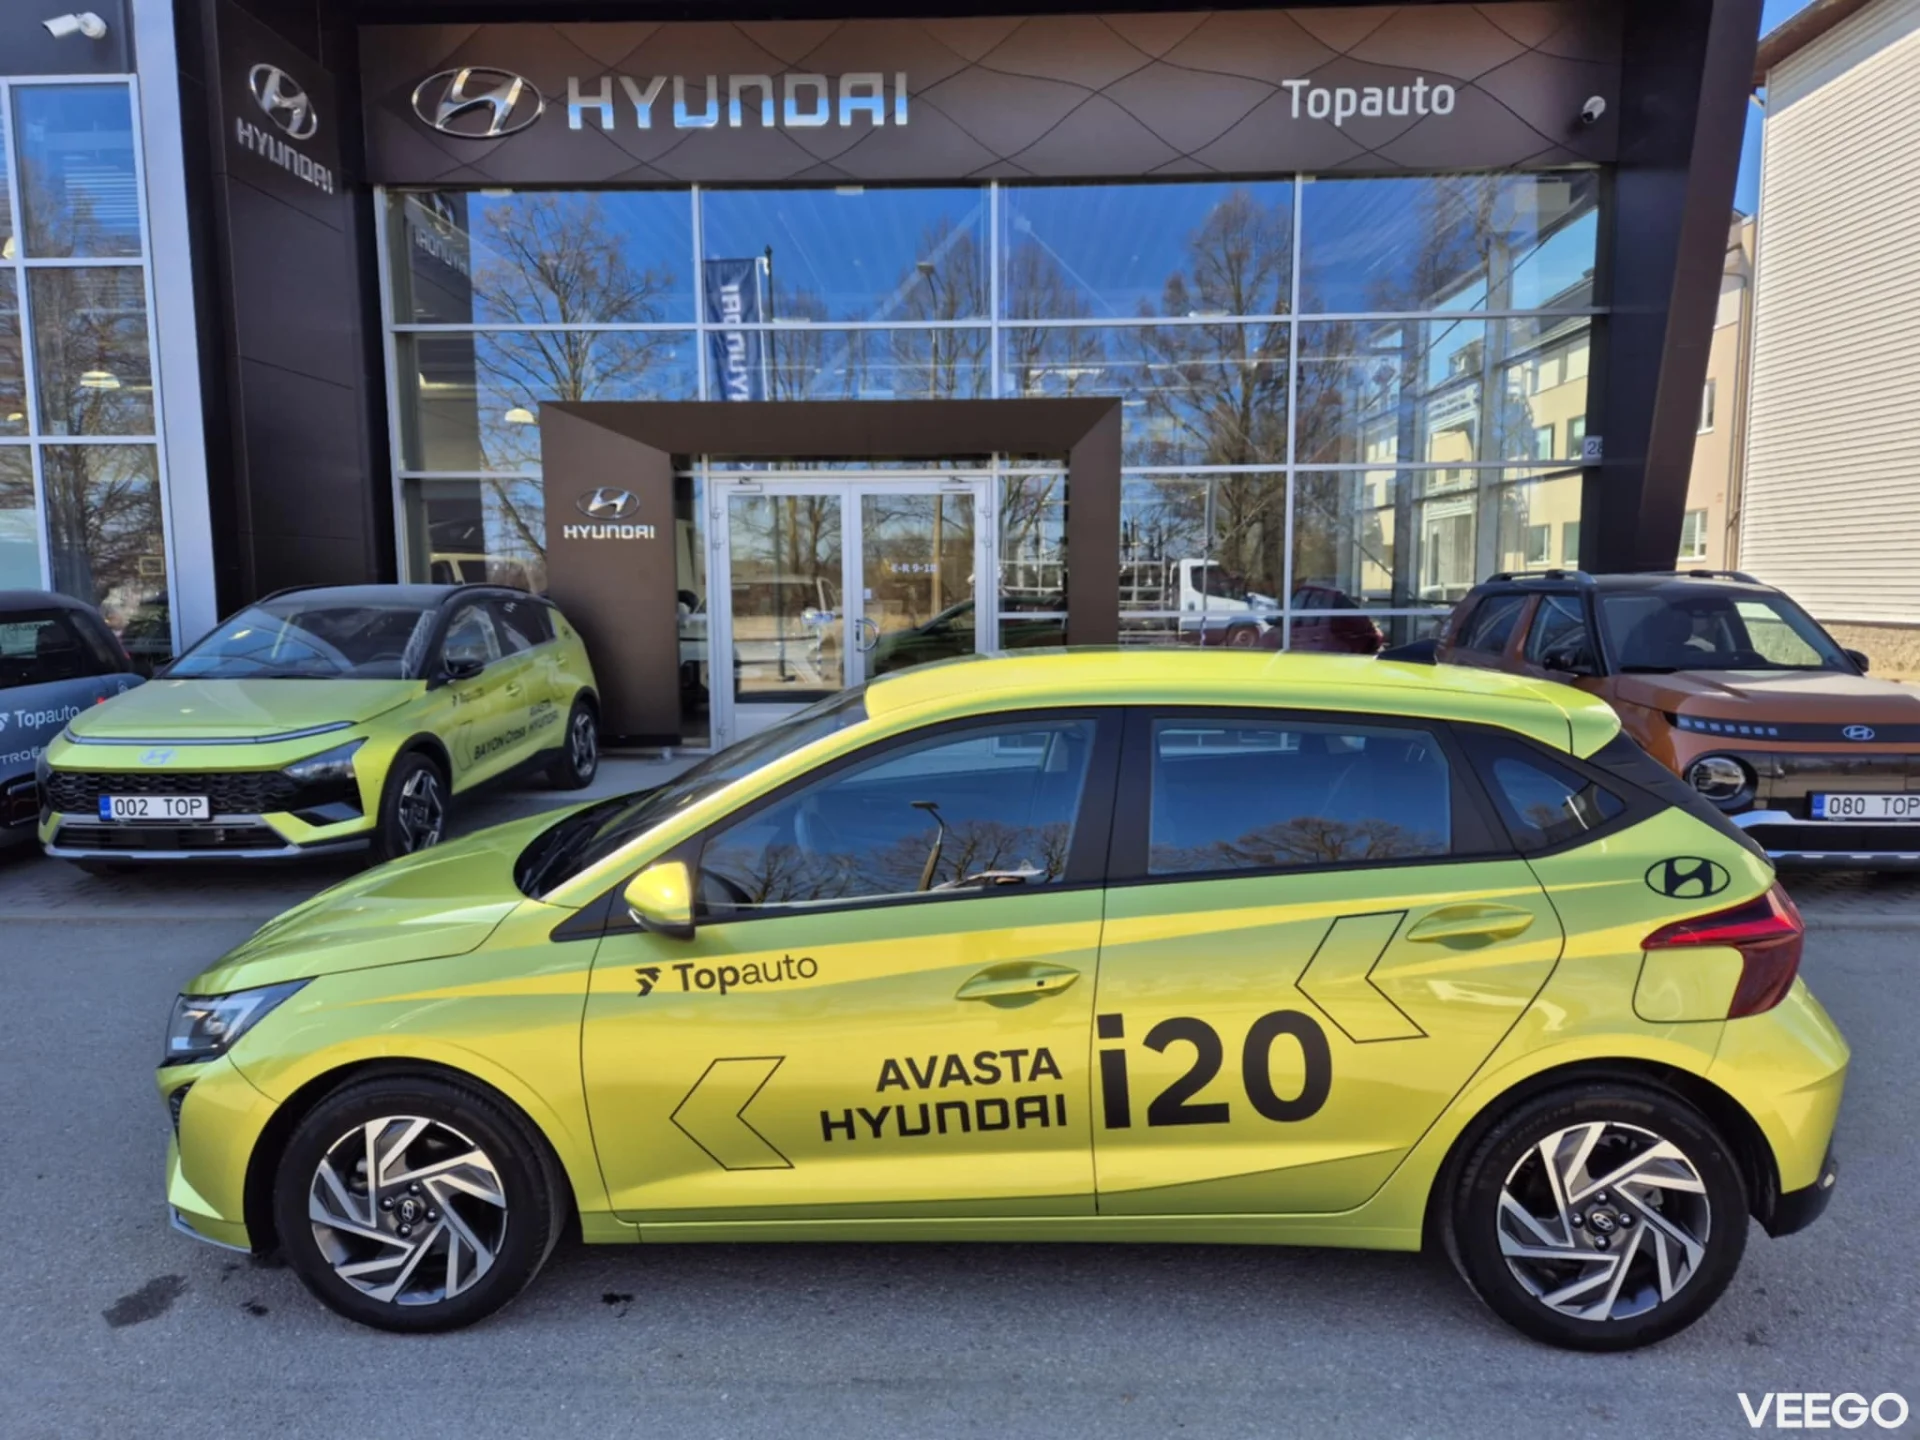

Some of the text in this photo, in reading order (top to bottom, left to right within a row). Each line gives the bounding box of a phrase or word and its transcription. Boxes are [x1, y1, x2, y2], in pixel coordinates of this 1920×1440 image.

[567, 72, 908, 130] HYUNDAI
[1281, 76, 1456, 127] Topauto
[236, 116, 334, 195] HYUNDAI
[563, 524, 655, 539] HYUNDAI
[14, 705, 81, 729] Topauto
[114, 798, 203, 816] 002 TOP
[1829, 797, 1920, 815] 080 TOP
[671, 952, 819, 996] Topauto
[875, 1046, 1063, 1093] AVASTA
[1096, 1009, 1333, 1131] i20
[819, 1093, 1068, 1142] HYUNDAI
